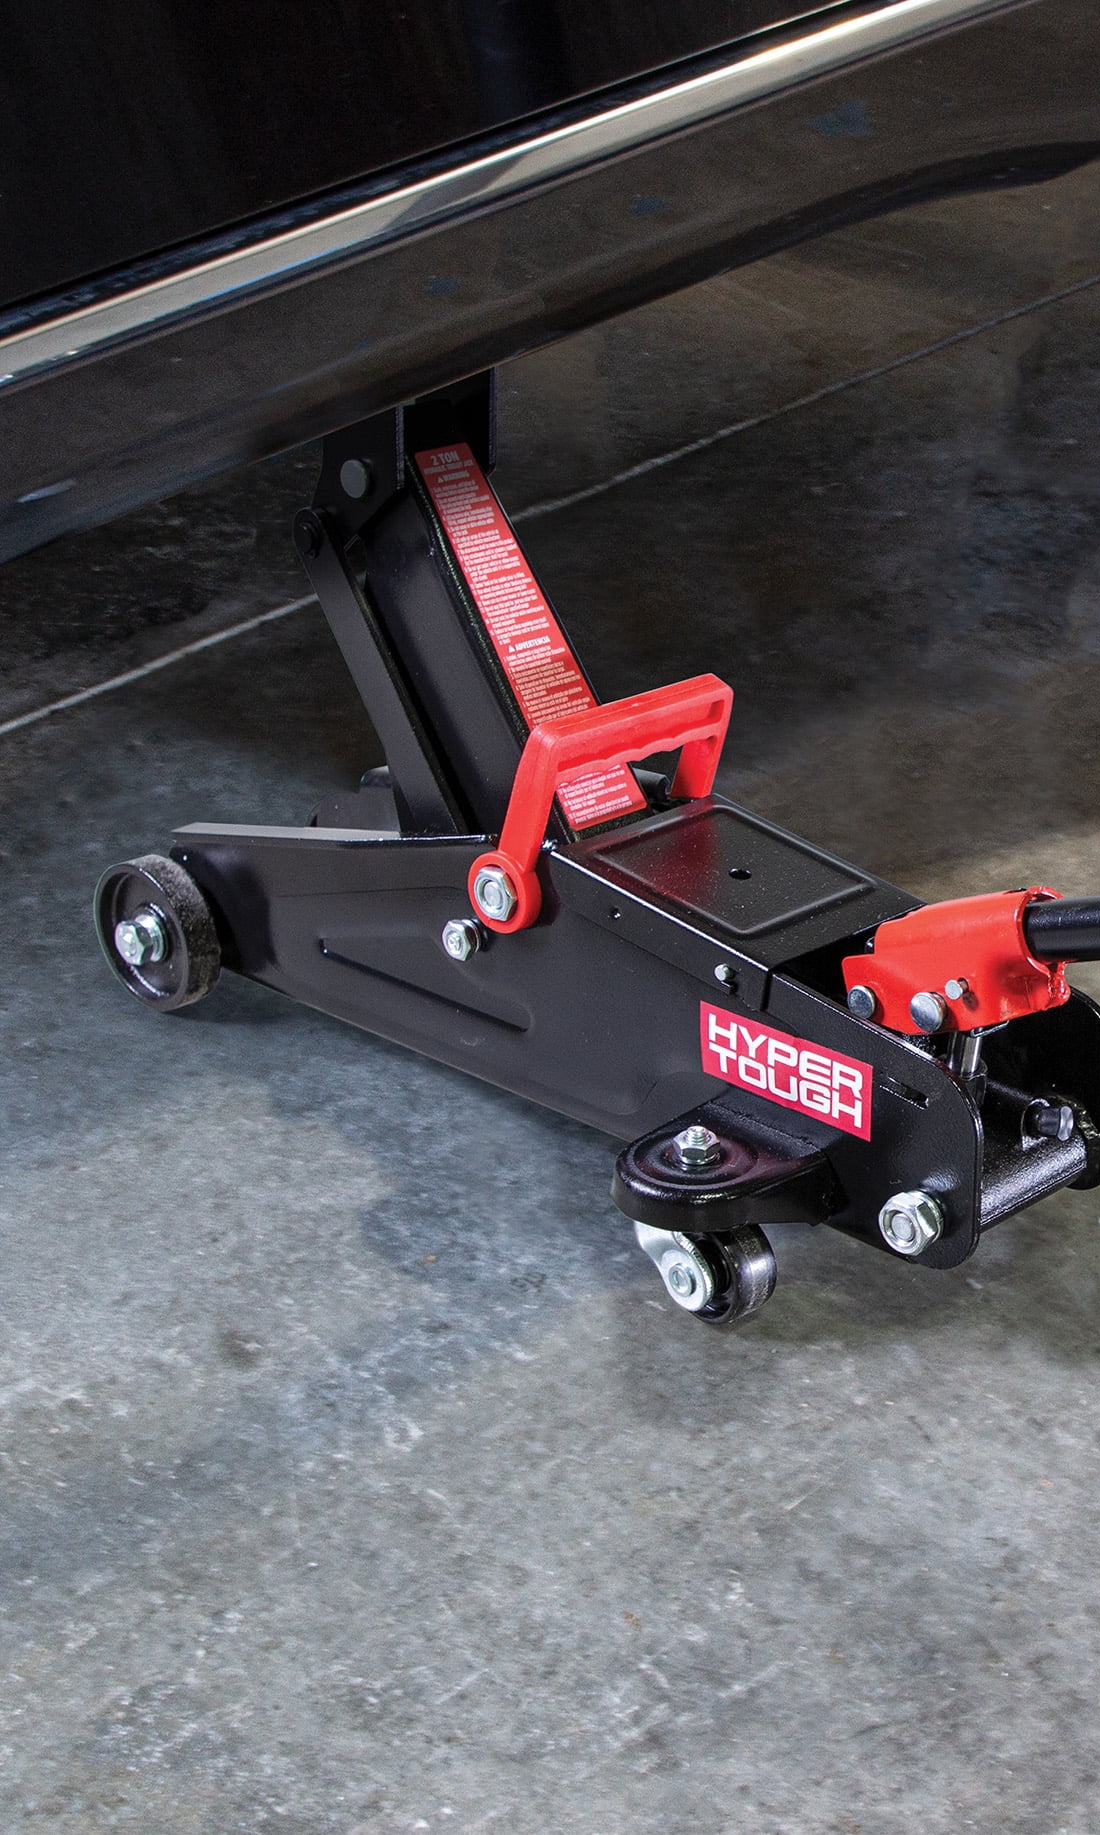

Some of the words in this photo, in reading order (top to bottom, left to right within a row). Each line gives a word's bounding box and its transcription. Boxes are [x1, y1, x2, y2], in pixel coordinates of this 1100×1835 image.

[430, 455, 440, 466] 2
[438, 451, 460, 465] TON
[708, 1013, 864, 1100] HYPER
[708, 1042, 863, 1129] TOUGH
